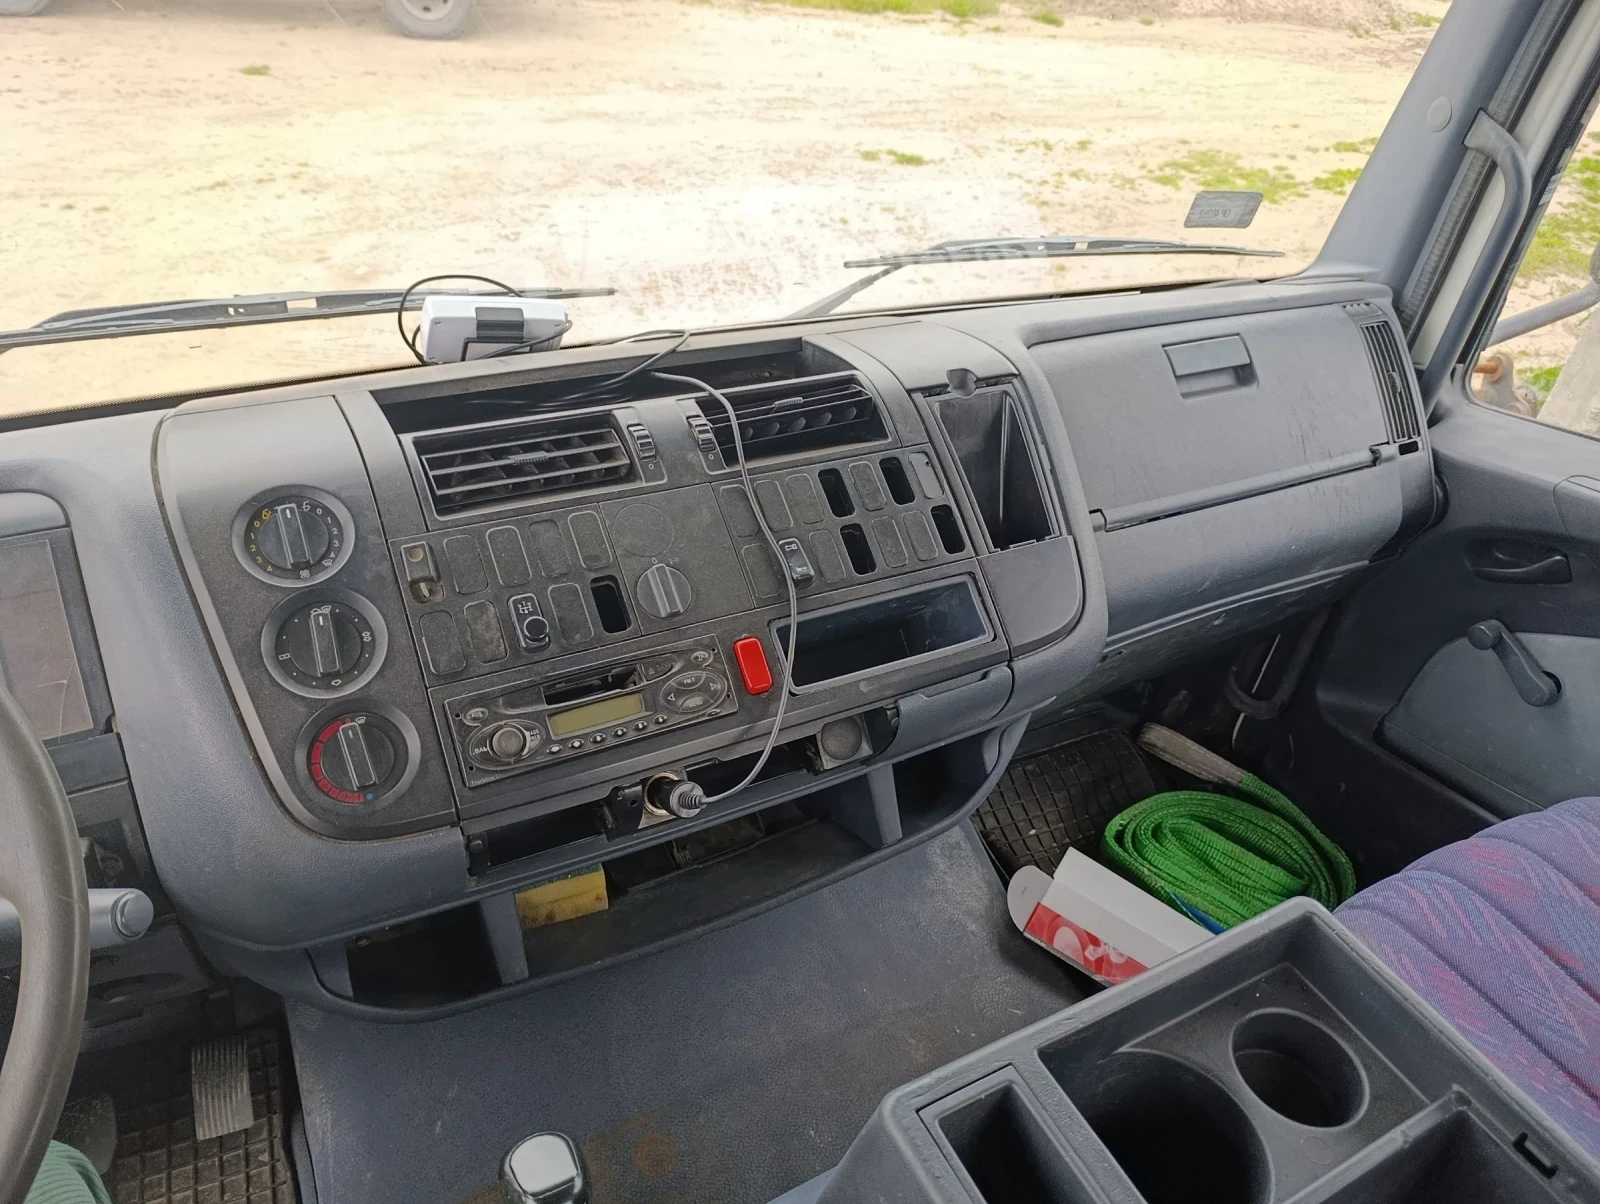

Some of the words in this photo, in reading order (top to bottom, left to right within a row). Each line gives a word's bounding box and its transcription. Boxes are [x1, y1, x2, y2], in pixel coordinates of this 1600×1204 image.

[253, 520, 260, 528] 0
[327, 516, 332, 524] 1
[250, 532, 255, 540] 1
[250, 544, 257, 552] 2
[266, 564, 273, 572] 4
